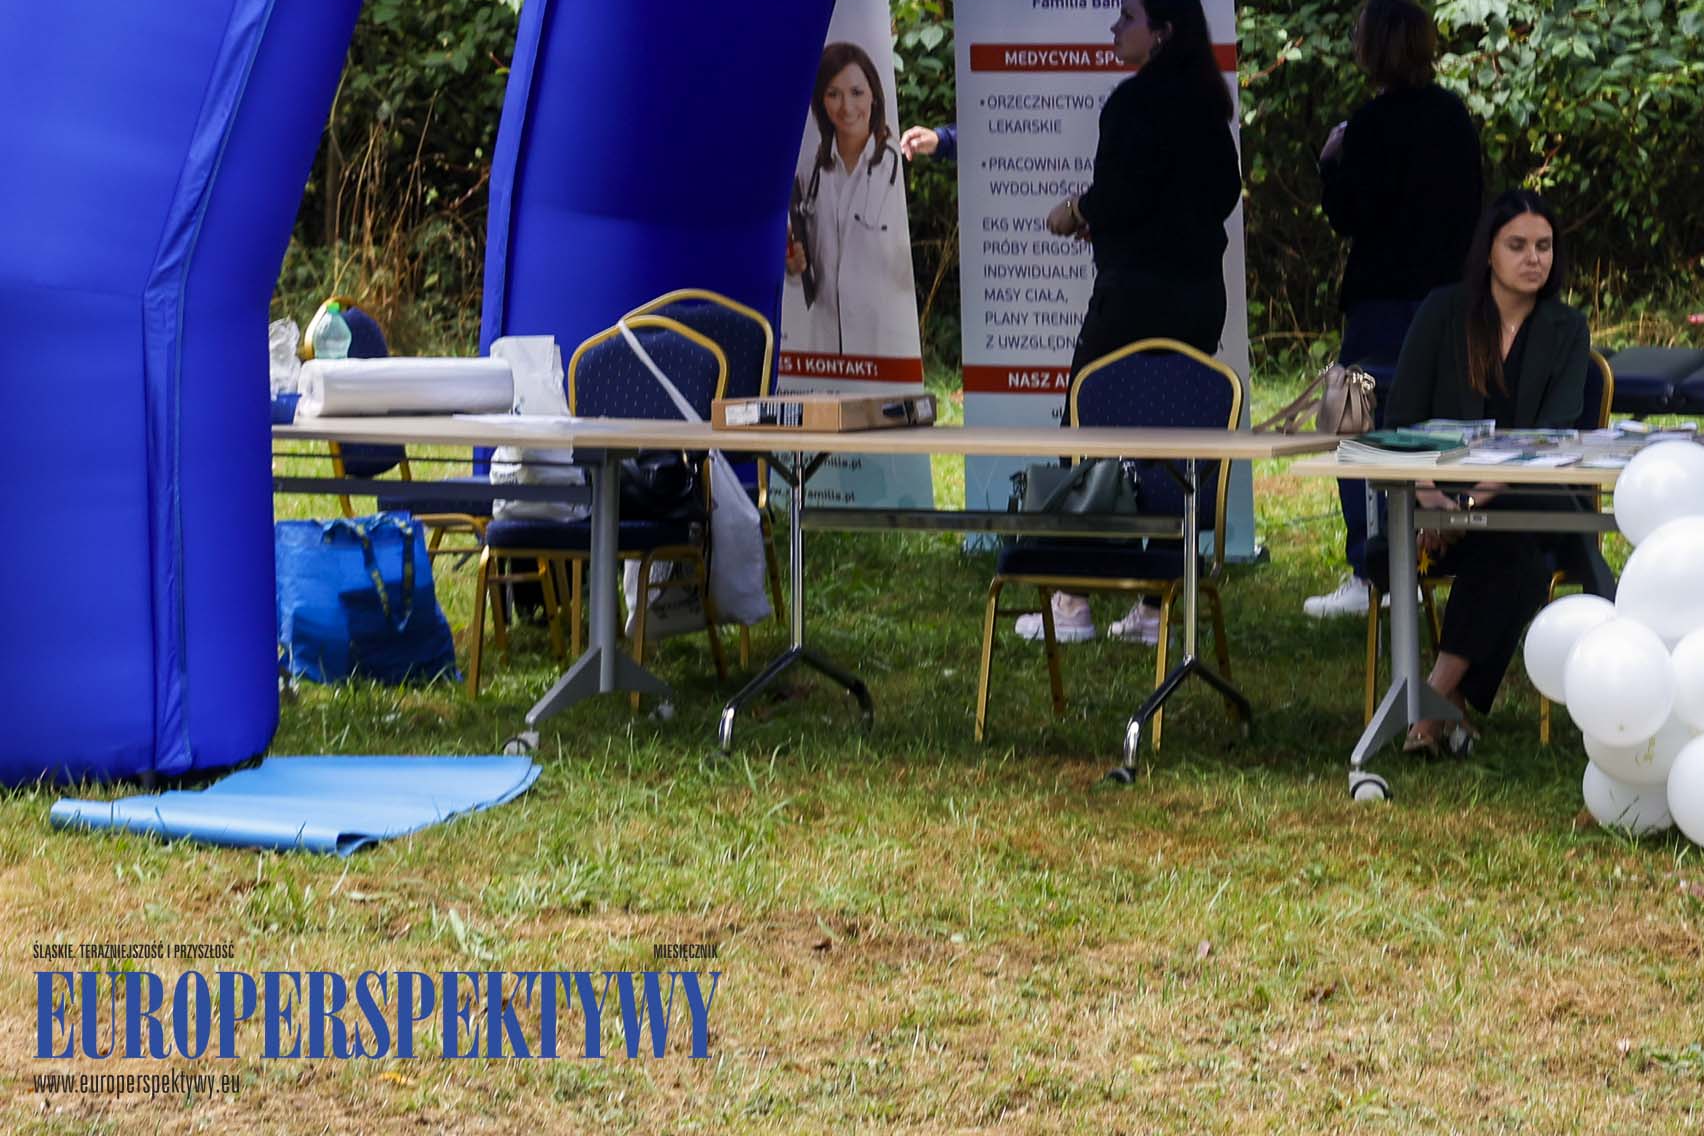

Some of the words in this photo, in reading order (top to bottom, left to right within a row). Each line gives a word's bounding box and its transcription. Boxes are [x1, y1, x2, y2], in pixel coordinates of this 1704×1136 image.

[1004, 50, 1089, 65] MEDYCYNA
[986, 94, 1094, 109] ORZECZNICTWO
[987, 119, 1061, 133] LEKARSKIE
[988, 156, 1070, 170] PRACOWNIA
[989, 179, 1089, 195] WYDOLNOŚCIO
[981, 217, 1008, 231] EKG
[982, 239, 1027, 255] PRÓBY
[1031, 241, 1092, 255] ERGOSPI
[983, 264, 1087, 278] INDYWIDUALNE
[983, 288, 1020, 301] MASY
[984, 311, 1027, 324] PLANY
[1032, 311, 1083, 325] TRENIN
[986, 334, 995, 350] Z
[998, 334, 1076, 352] UWZGLĘDN
[804, 357, 877, 375] KONTAKT:
[1007, 372, 1049, 387] NASZ
